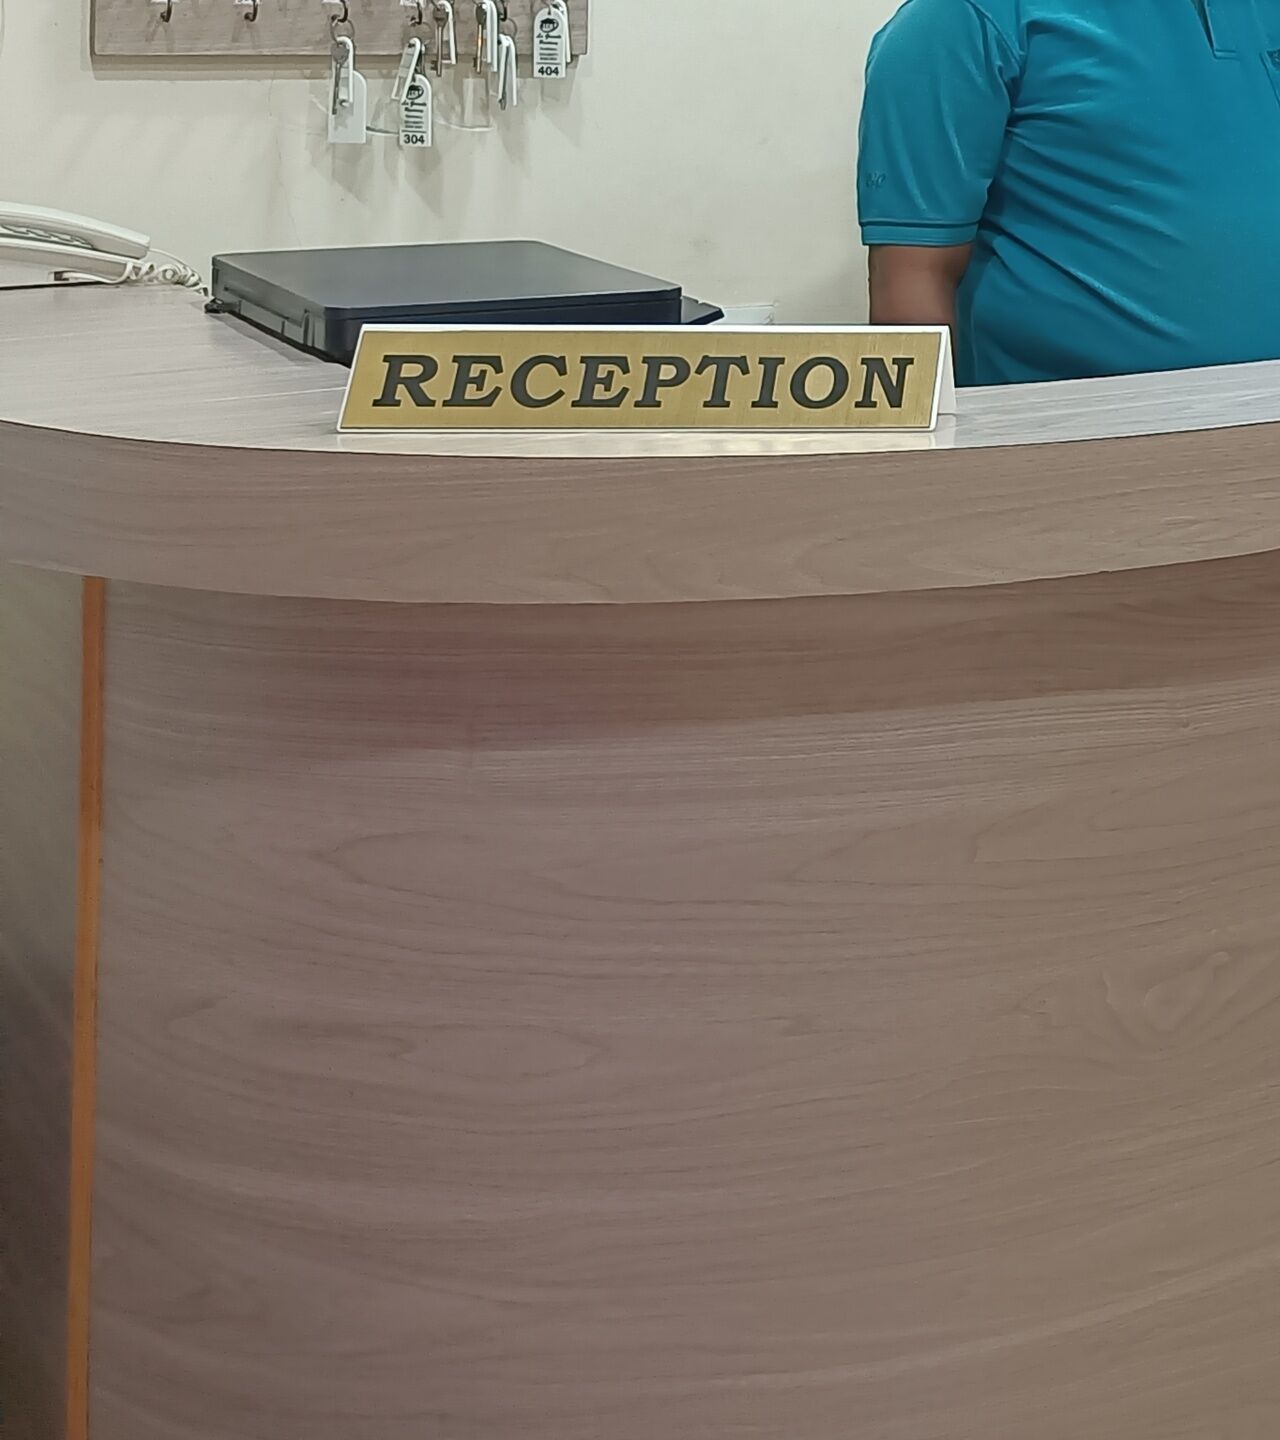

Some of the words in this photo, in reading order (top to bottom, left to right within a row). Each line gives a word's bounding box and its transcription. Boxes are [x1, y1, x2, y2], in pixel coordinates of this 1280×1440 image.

[537, 65, 560, 76] 404
[403, 134, 426, 144] 304
[371, 353, 915, 410] RECEPTION
